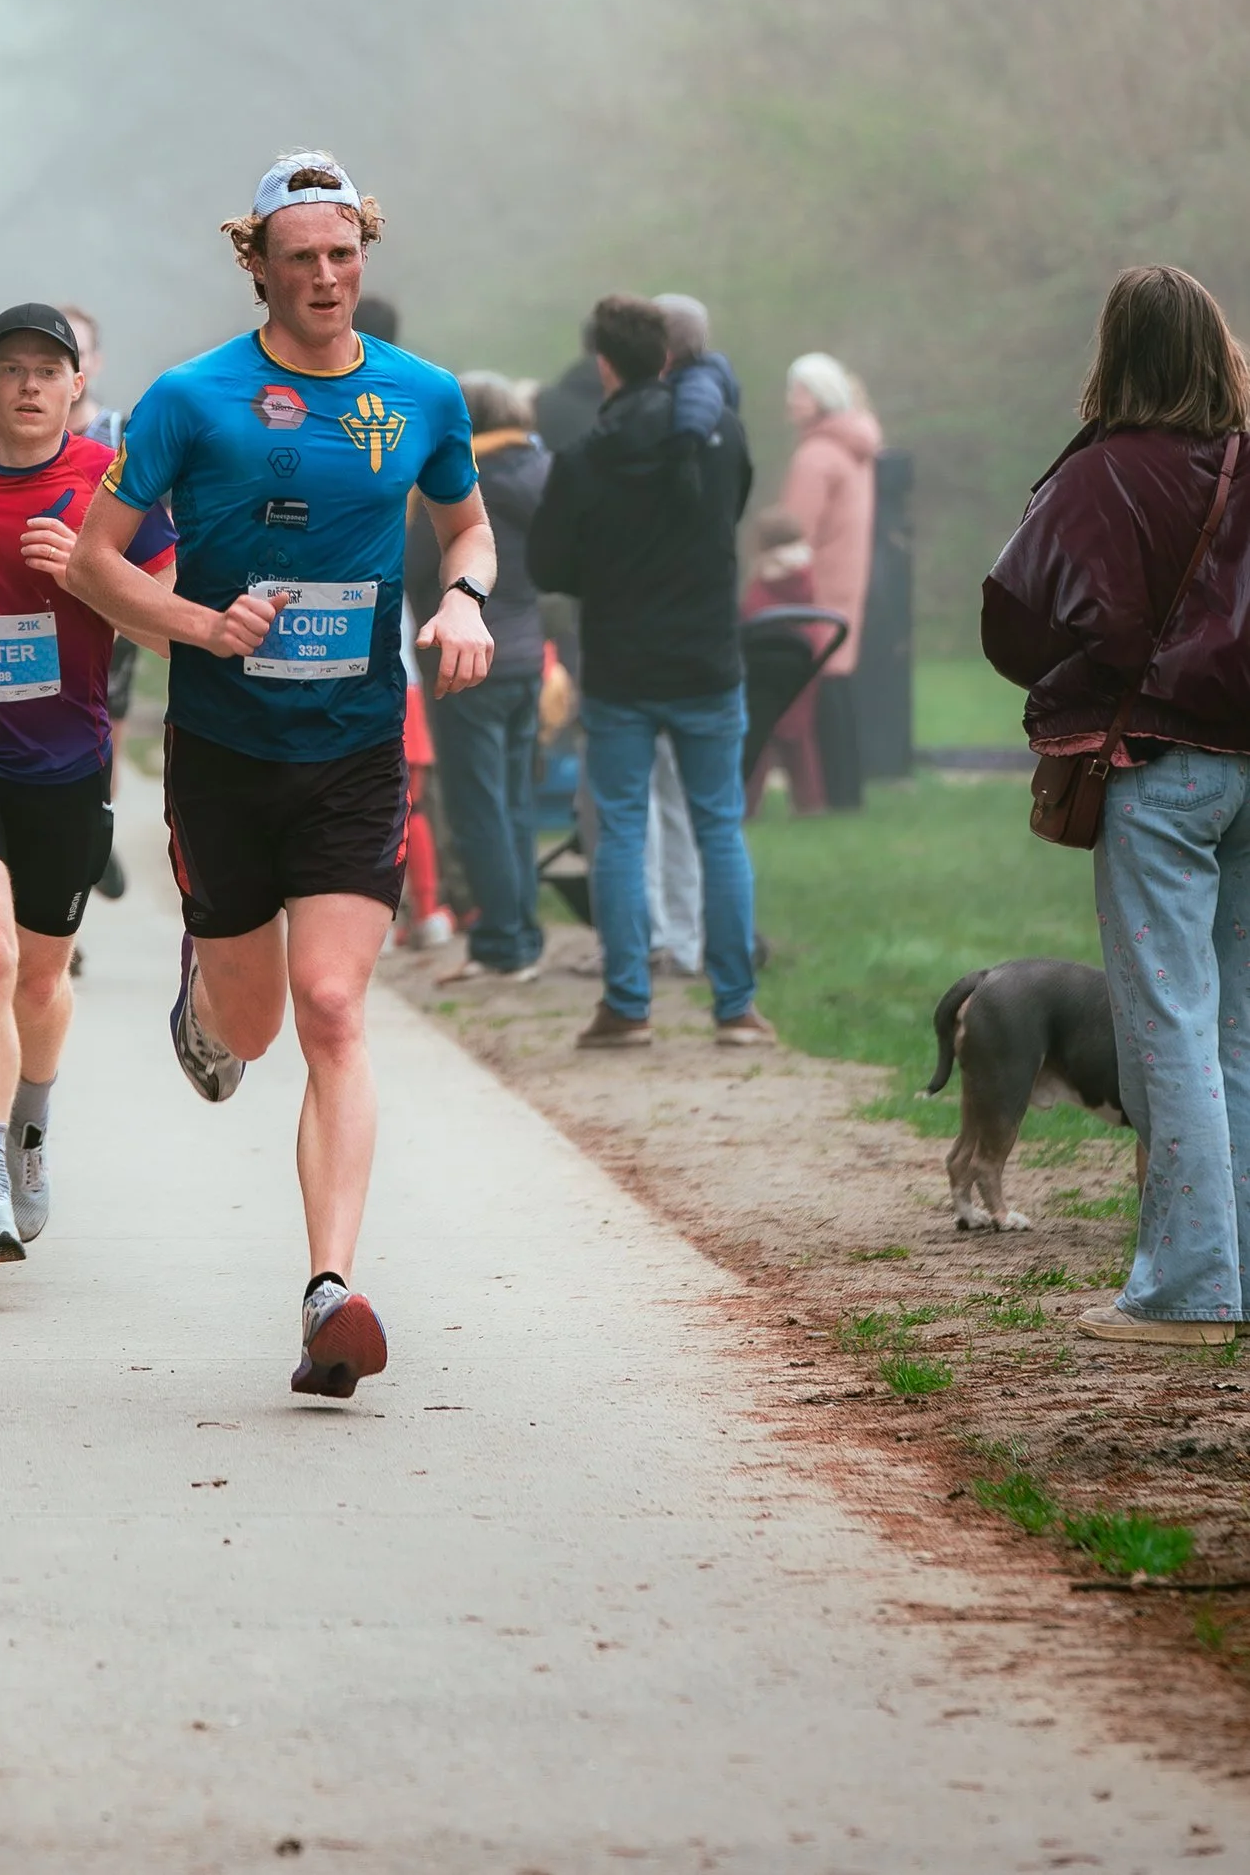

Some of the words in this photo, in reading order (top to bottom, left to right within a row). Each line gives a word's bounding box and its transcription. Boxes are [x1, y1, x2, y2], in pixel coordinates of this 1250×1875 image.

[341, 590, 363, 601] 21K
[17, 620, 41, 632] 21K
[278, 615, 348, 636] LOUIS
[297, 644, 327, 657] 3320
[66, 891, 83, 922] FUSION
